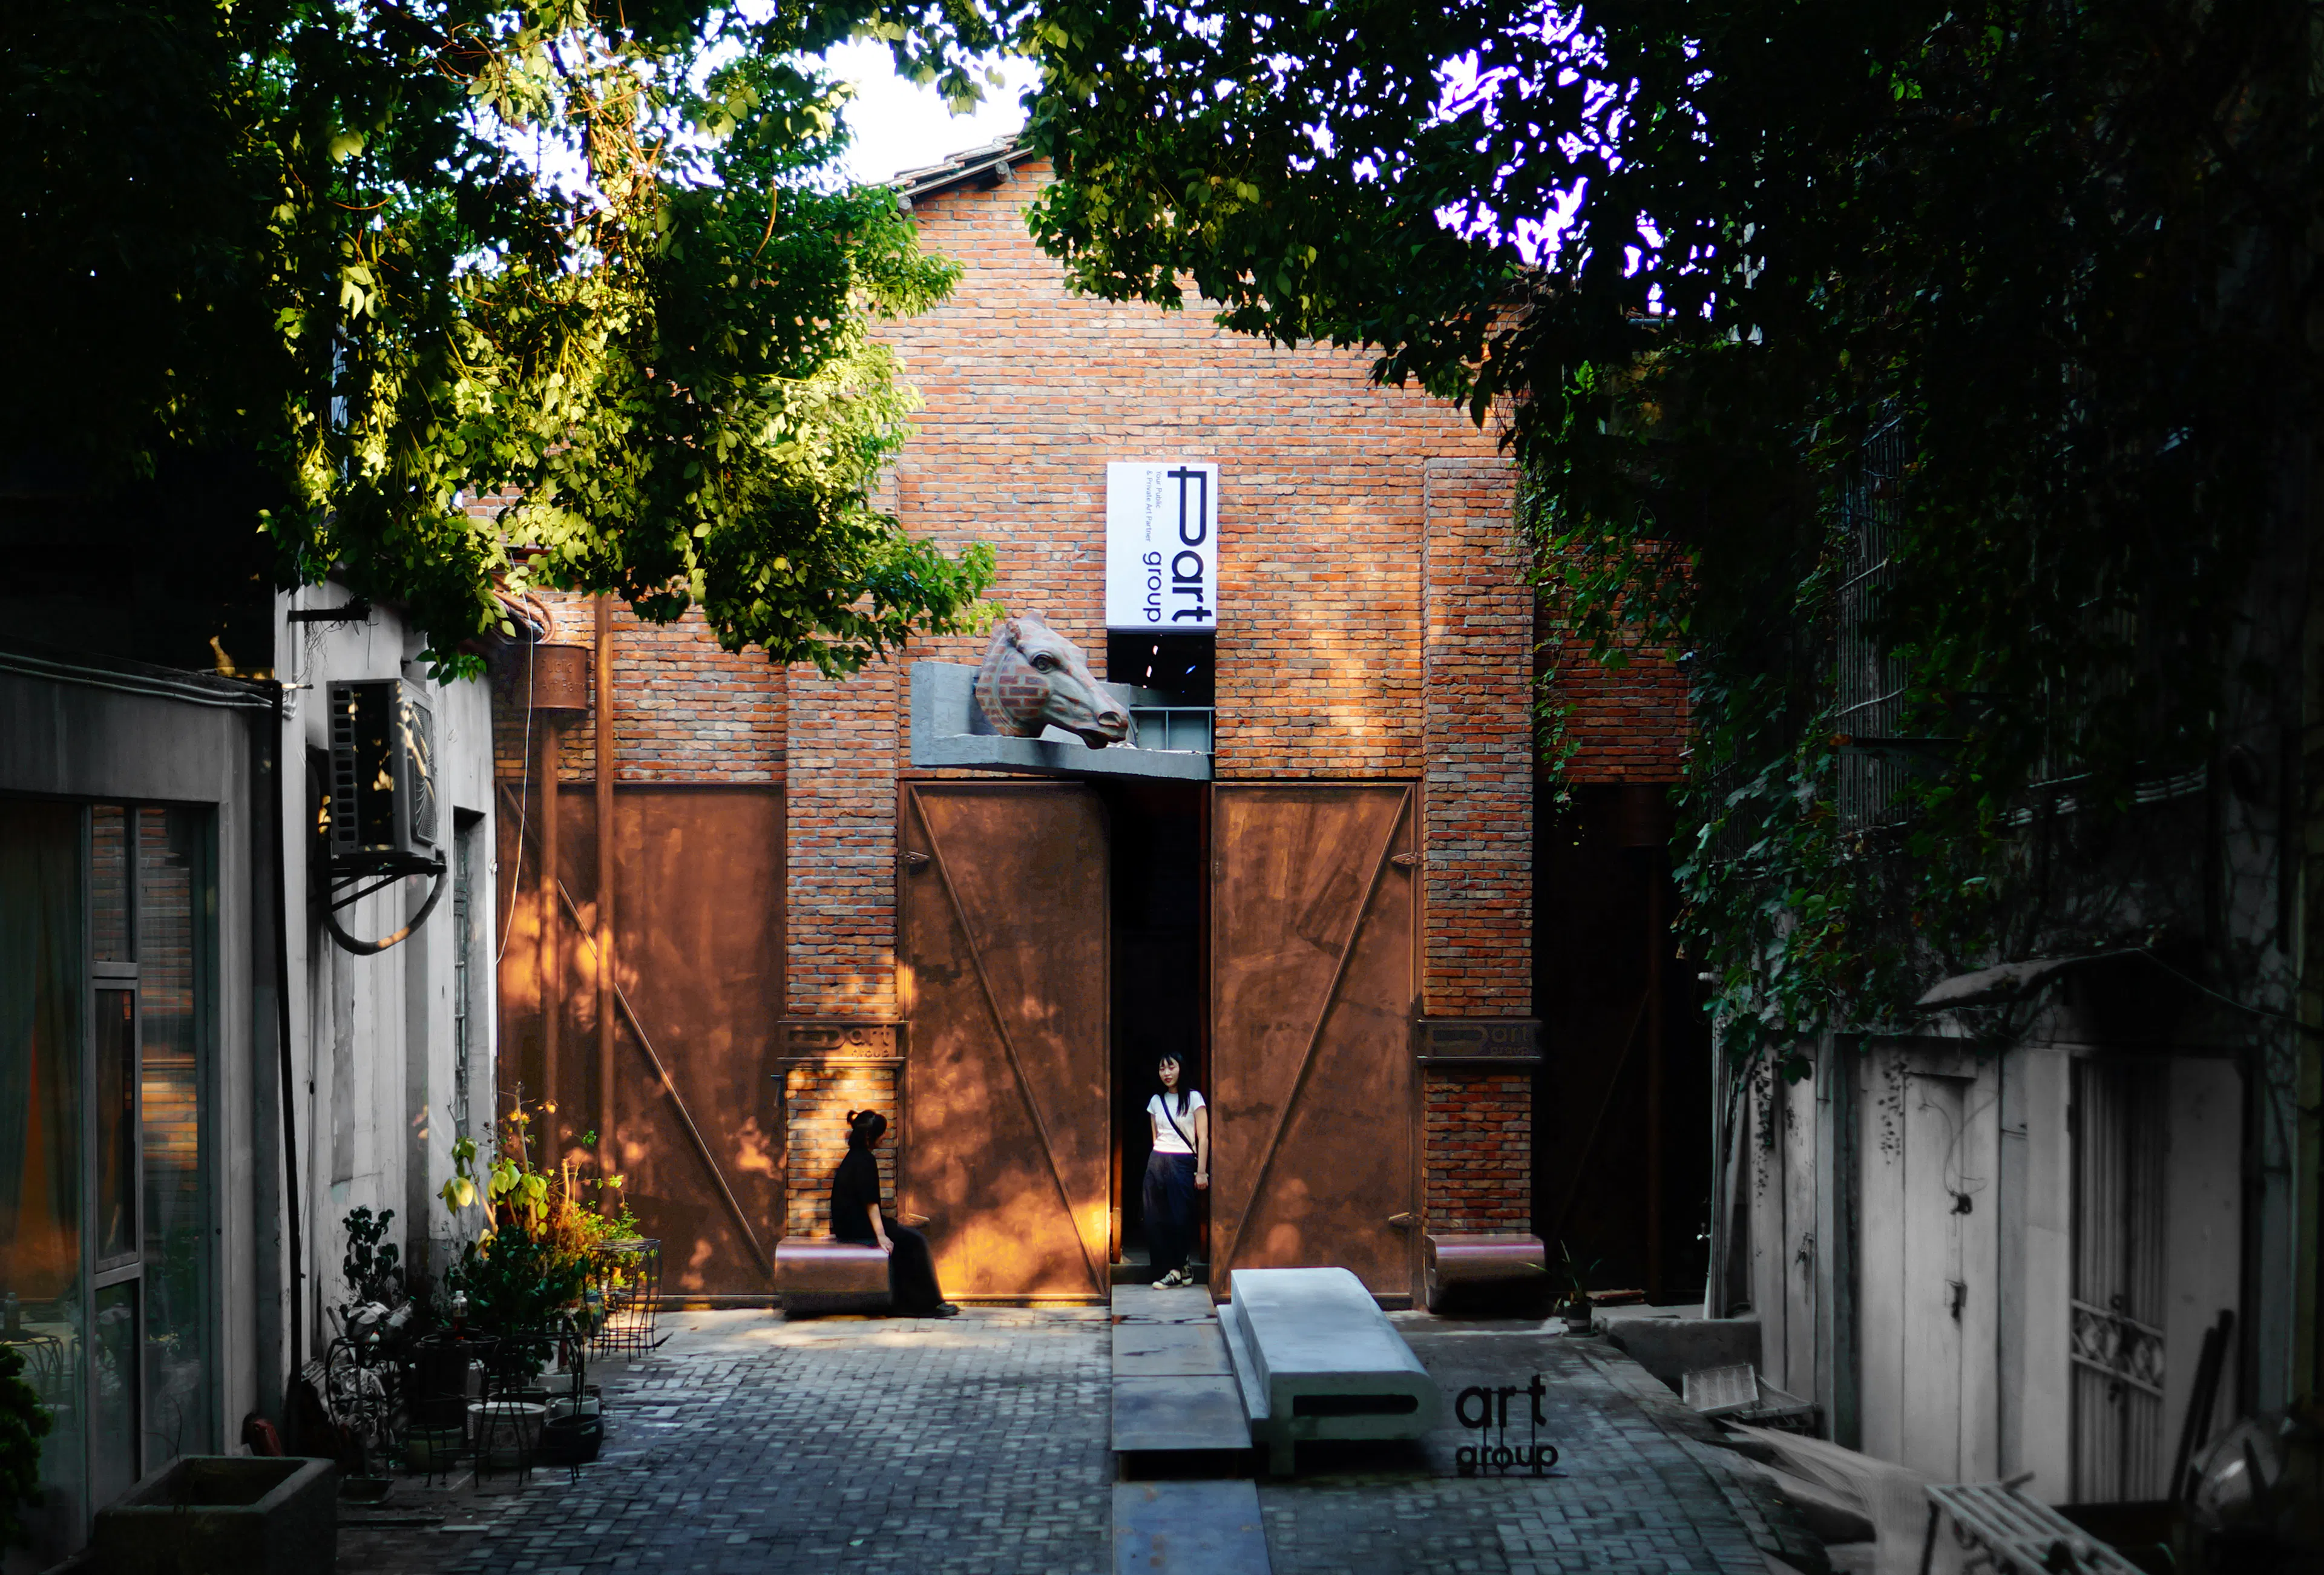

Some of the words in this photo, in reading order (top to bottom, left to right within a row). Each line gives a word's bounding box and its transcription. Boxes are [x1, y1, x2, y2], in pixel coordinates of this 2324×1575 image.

[1167, 465, 1212, 622] Part
[1142, 551, 1162, 623] group
[1456, 1444, 1558, 1476] group
